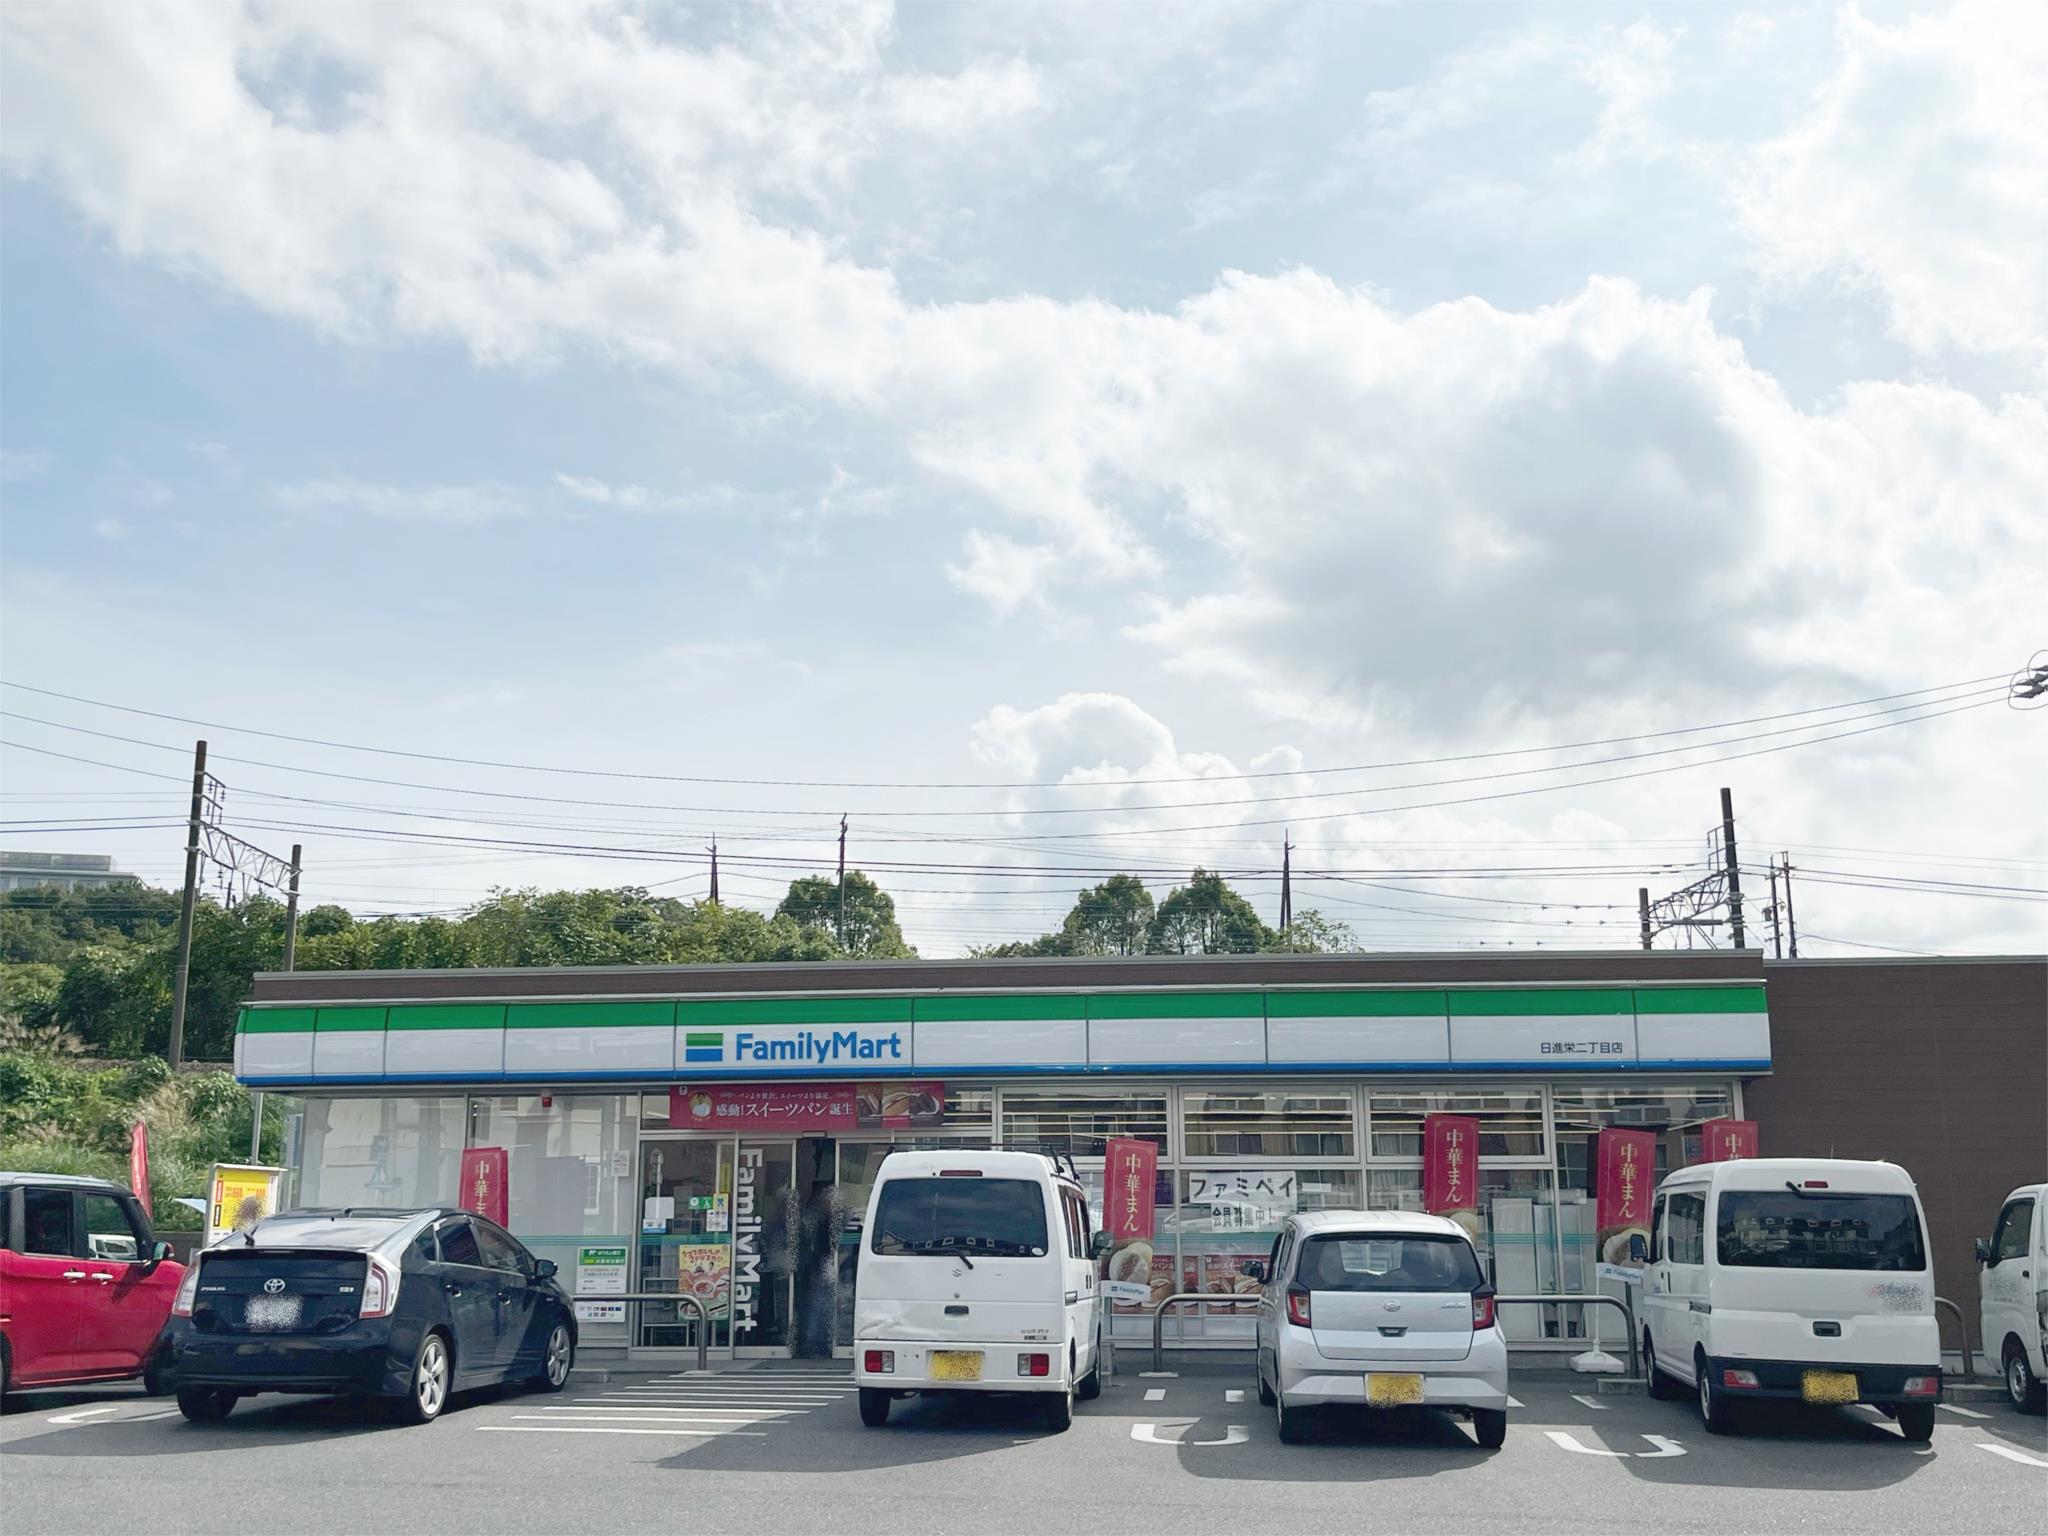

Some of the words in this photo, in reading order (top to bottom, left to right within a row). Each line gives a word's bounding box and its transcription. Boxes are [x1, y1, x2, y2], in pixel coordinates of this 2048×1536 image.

[736, 1031, 901, 1064] FamilyMart
[1541, 1042, 1623, 1054] 日進栄二丁目店
[1123, 1153, 1142, 1232] 中華まん
[1191, 1177, 1294, 1198] ファミペイ
[1445, 1128, 1464, 1203] 中華まん
[1619, 1143, 1638, 1218] 中華まん
[735, 1148, 763, 1332] FamilyMart
